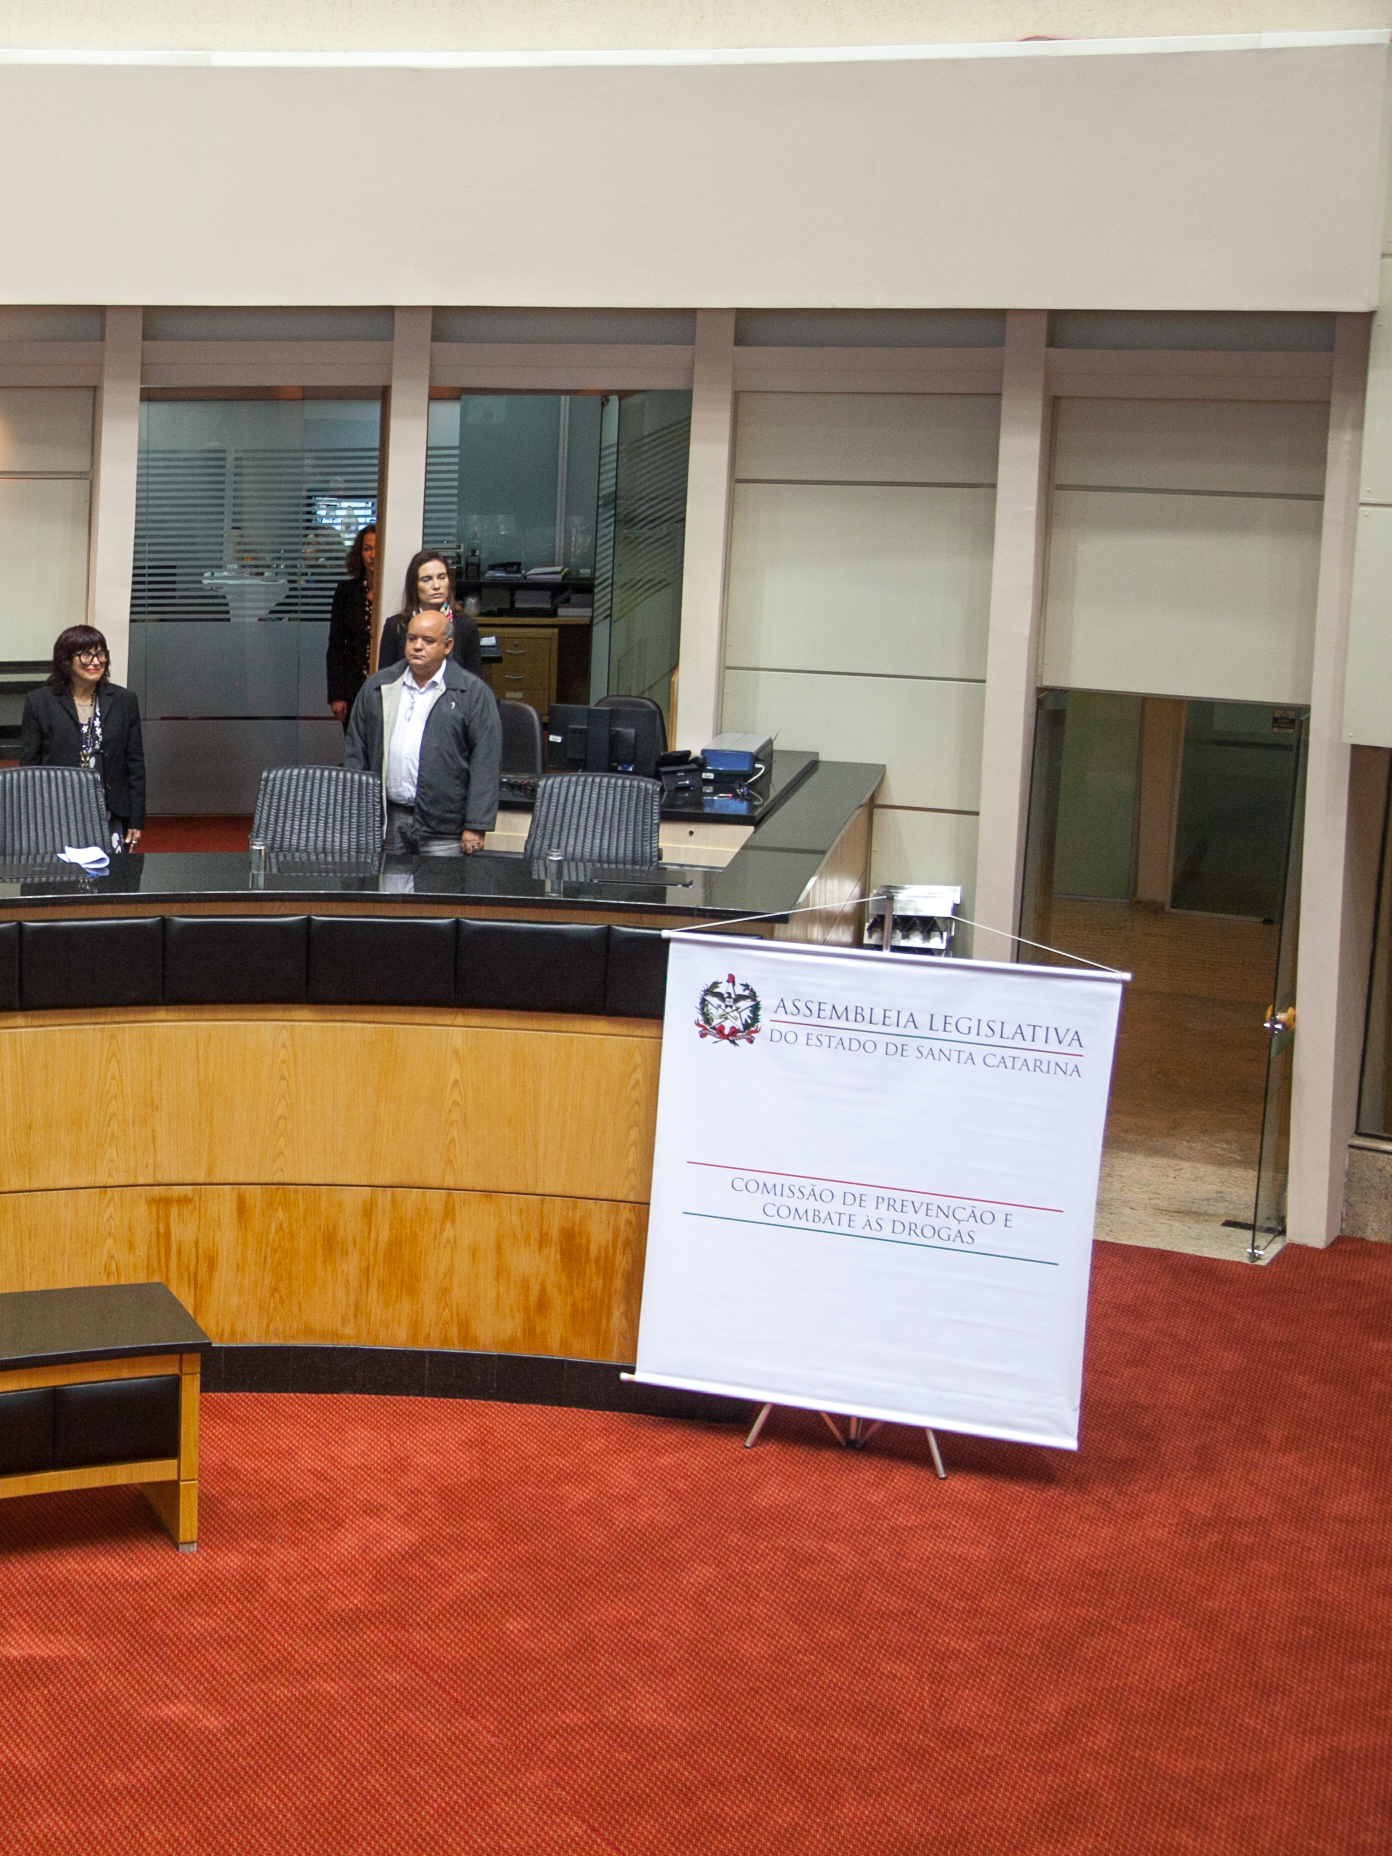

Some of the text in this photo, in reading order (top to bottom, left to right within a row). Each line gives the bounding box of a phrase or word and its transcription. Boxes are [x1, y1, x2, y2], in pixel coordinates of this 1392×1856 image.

[774, 998, 1084, 1048] ASSEMBLEIA LEGISLATIVA
[770, 1028, 1082, 1078] DO ESTADO DE SANTA CATARINA
[731, 1177, 1013, 1228] COMISSÃO DE PREVENÇÃO E
[762, 1202, 975, 1245] COMBATE ÀS DROGAS
